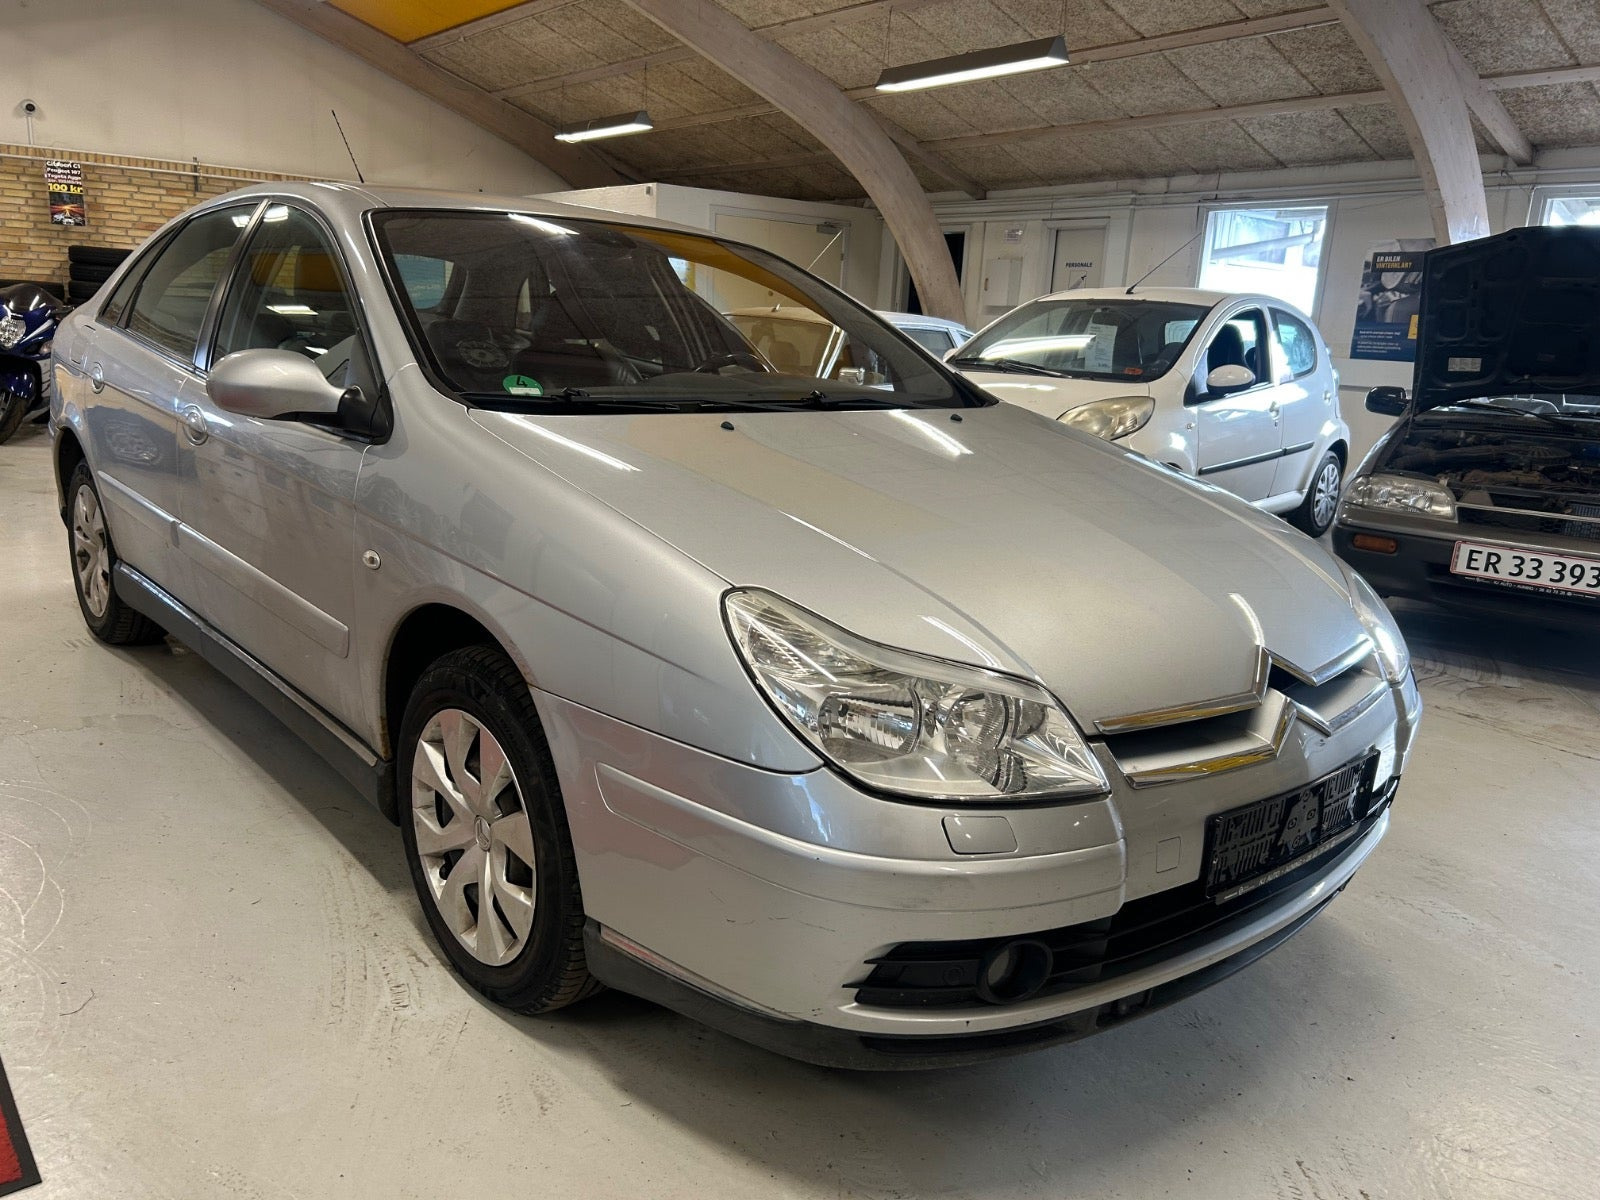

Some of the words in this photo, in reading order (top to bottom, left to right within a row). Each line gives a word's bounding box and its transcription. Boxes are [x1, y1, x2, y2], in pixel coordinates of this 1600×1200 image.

[48, 183, 68, 191] 100
[70, 185, 83, 193] kr
[516, 375, 528, 387] 4
[1465, 549, 1502, 574] ER
[1508, 555, 1543, 580] 33
[1549, 561, 1600, 588] 393
[1267, 870, 1281, 882] AUTO
